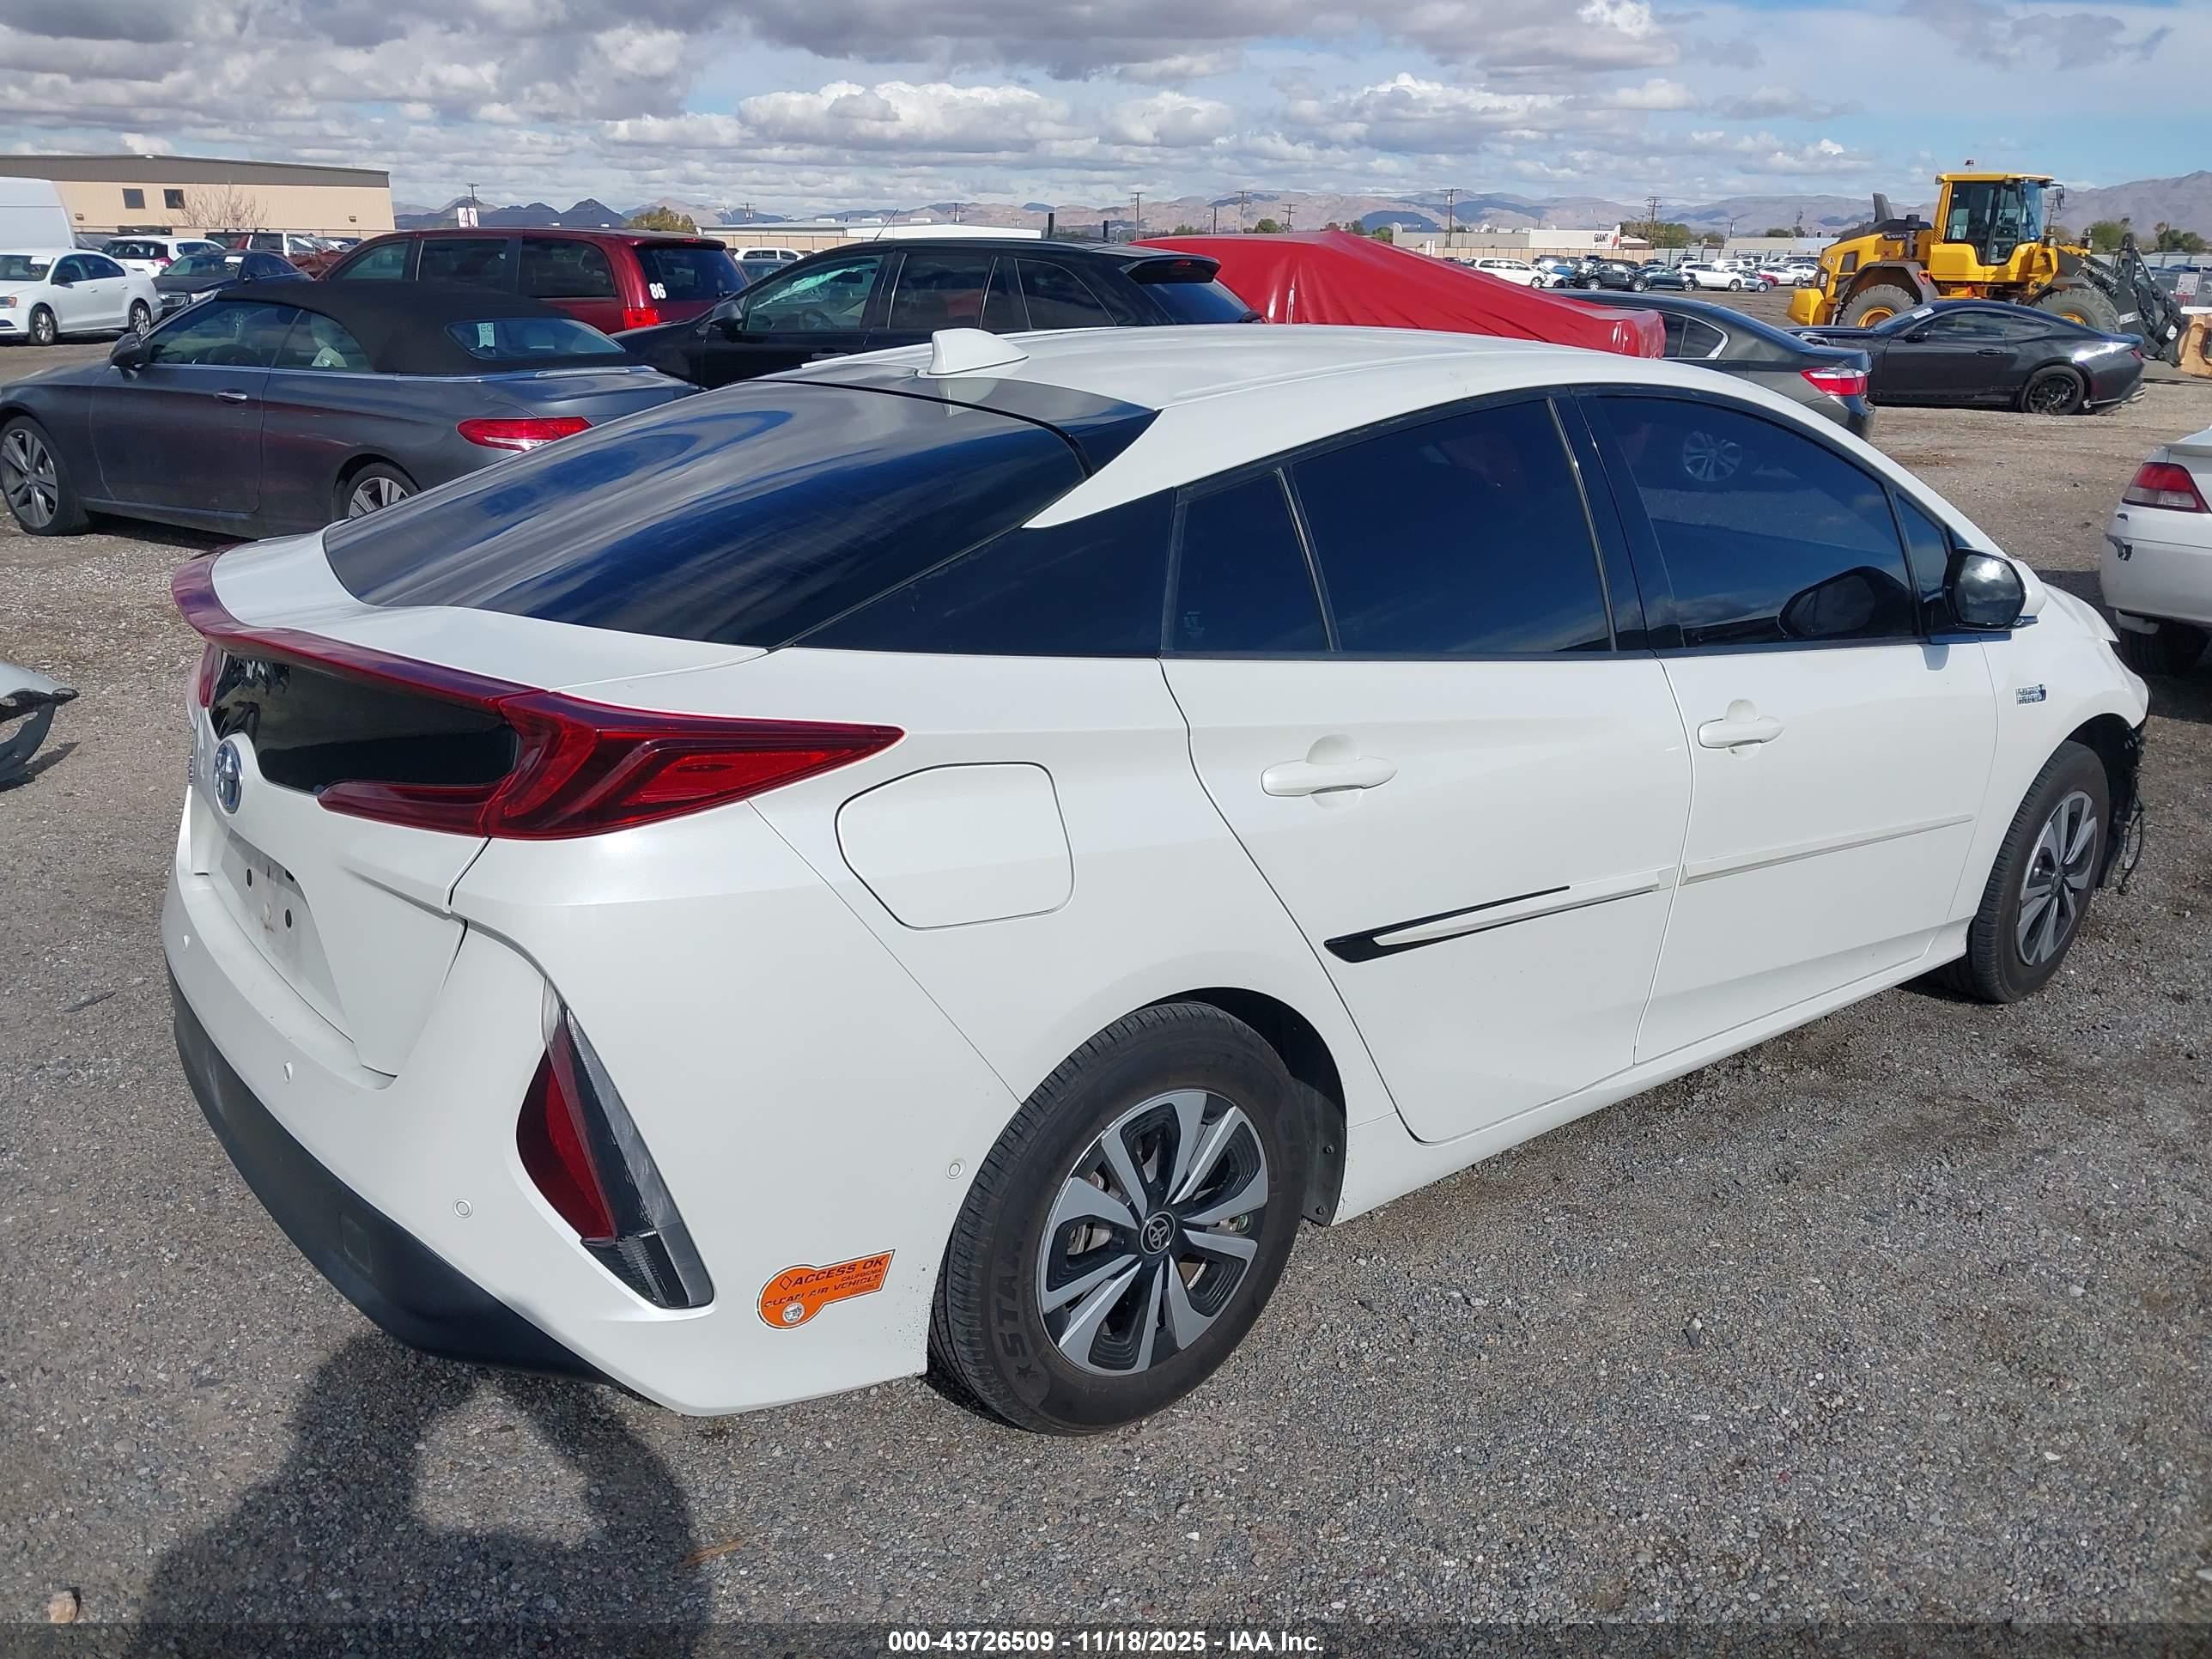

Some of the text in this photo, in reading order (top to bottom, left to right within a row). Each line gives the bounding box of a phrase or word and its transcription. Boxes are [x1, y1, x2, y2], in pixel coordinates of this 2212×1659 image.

[1594, 234, 1608, 242] GIANT
[649, 283, 666, 300] 86
[792, 1257, 885, 1287] ACCESS OK
[841, 1268, 882, 1282] CALIFORNIA
[763, 1293, 805, 1308] CLEAN
[808, 1287, 830, 1297] AIR
[834, 1274, 881, 1291] VEHICLE
